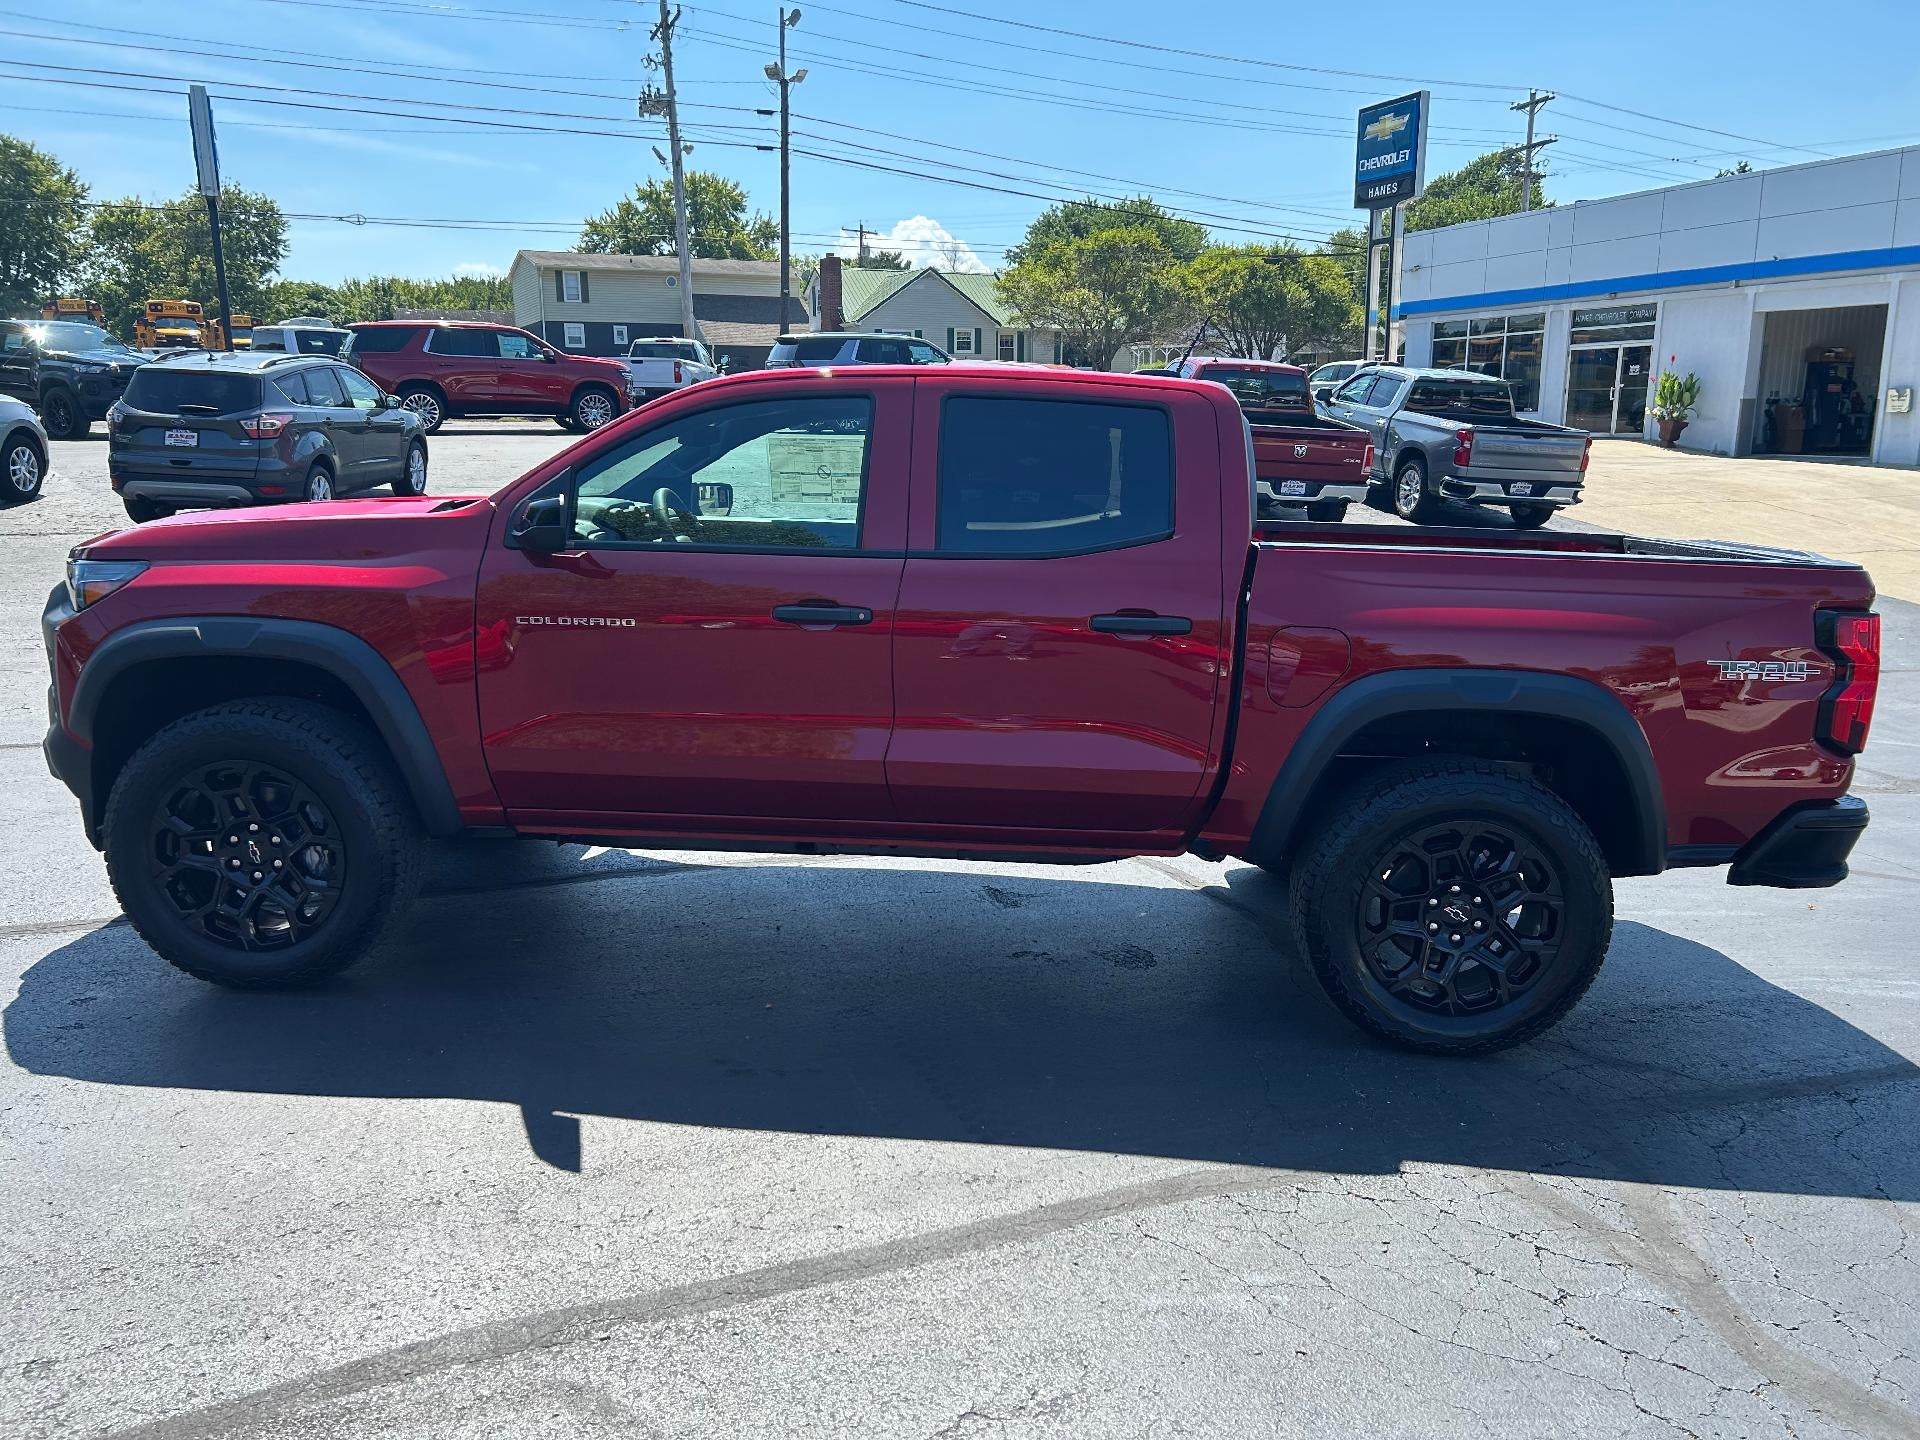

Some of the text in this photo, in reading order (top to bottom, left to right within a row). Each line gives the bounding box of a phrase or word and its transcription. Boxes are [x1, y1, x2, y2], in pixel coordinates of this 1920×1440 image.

[1359, 149, 1411, 171] CHEVROLET
[1368, 182, 1398, 198] HANES
[1595, 311, 1627, 321] CHEVROLET
[515, 616, 636, 627] COLORADO
[1706, 660, 1821, 674] TRAIL
